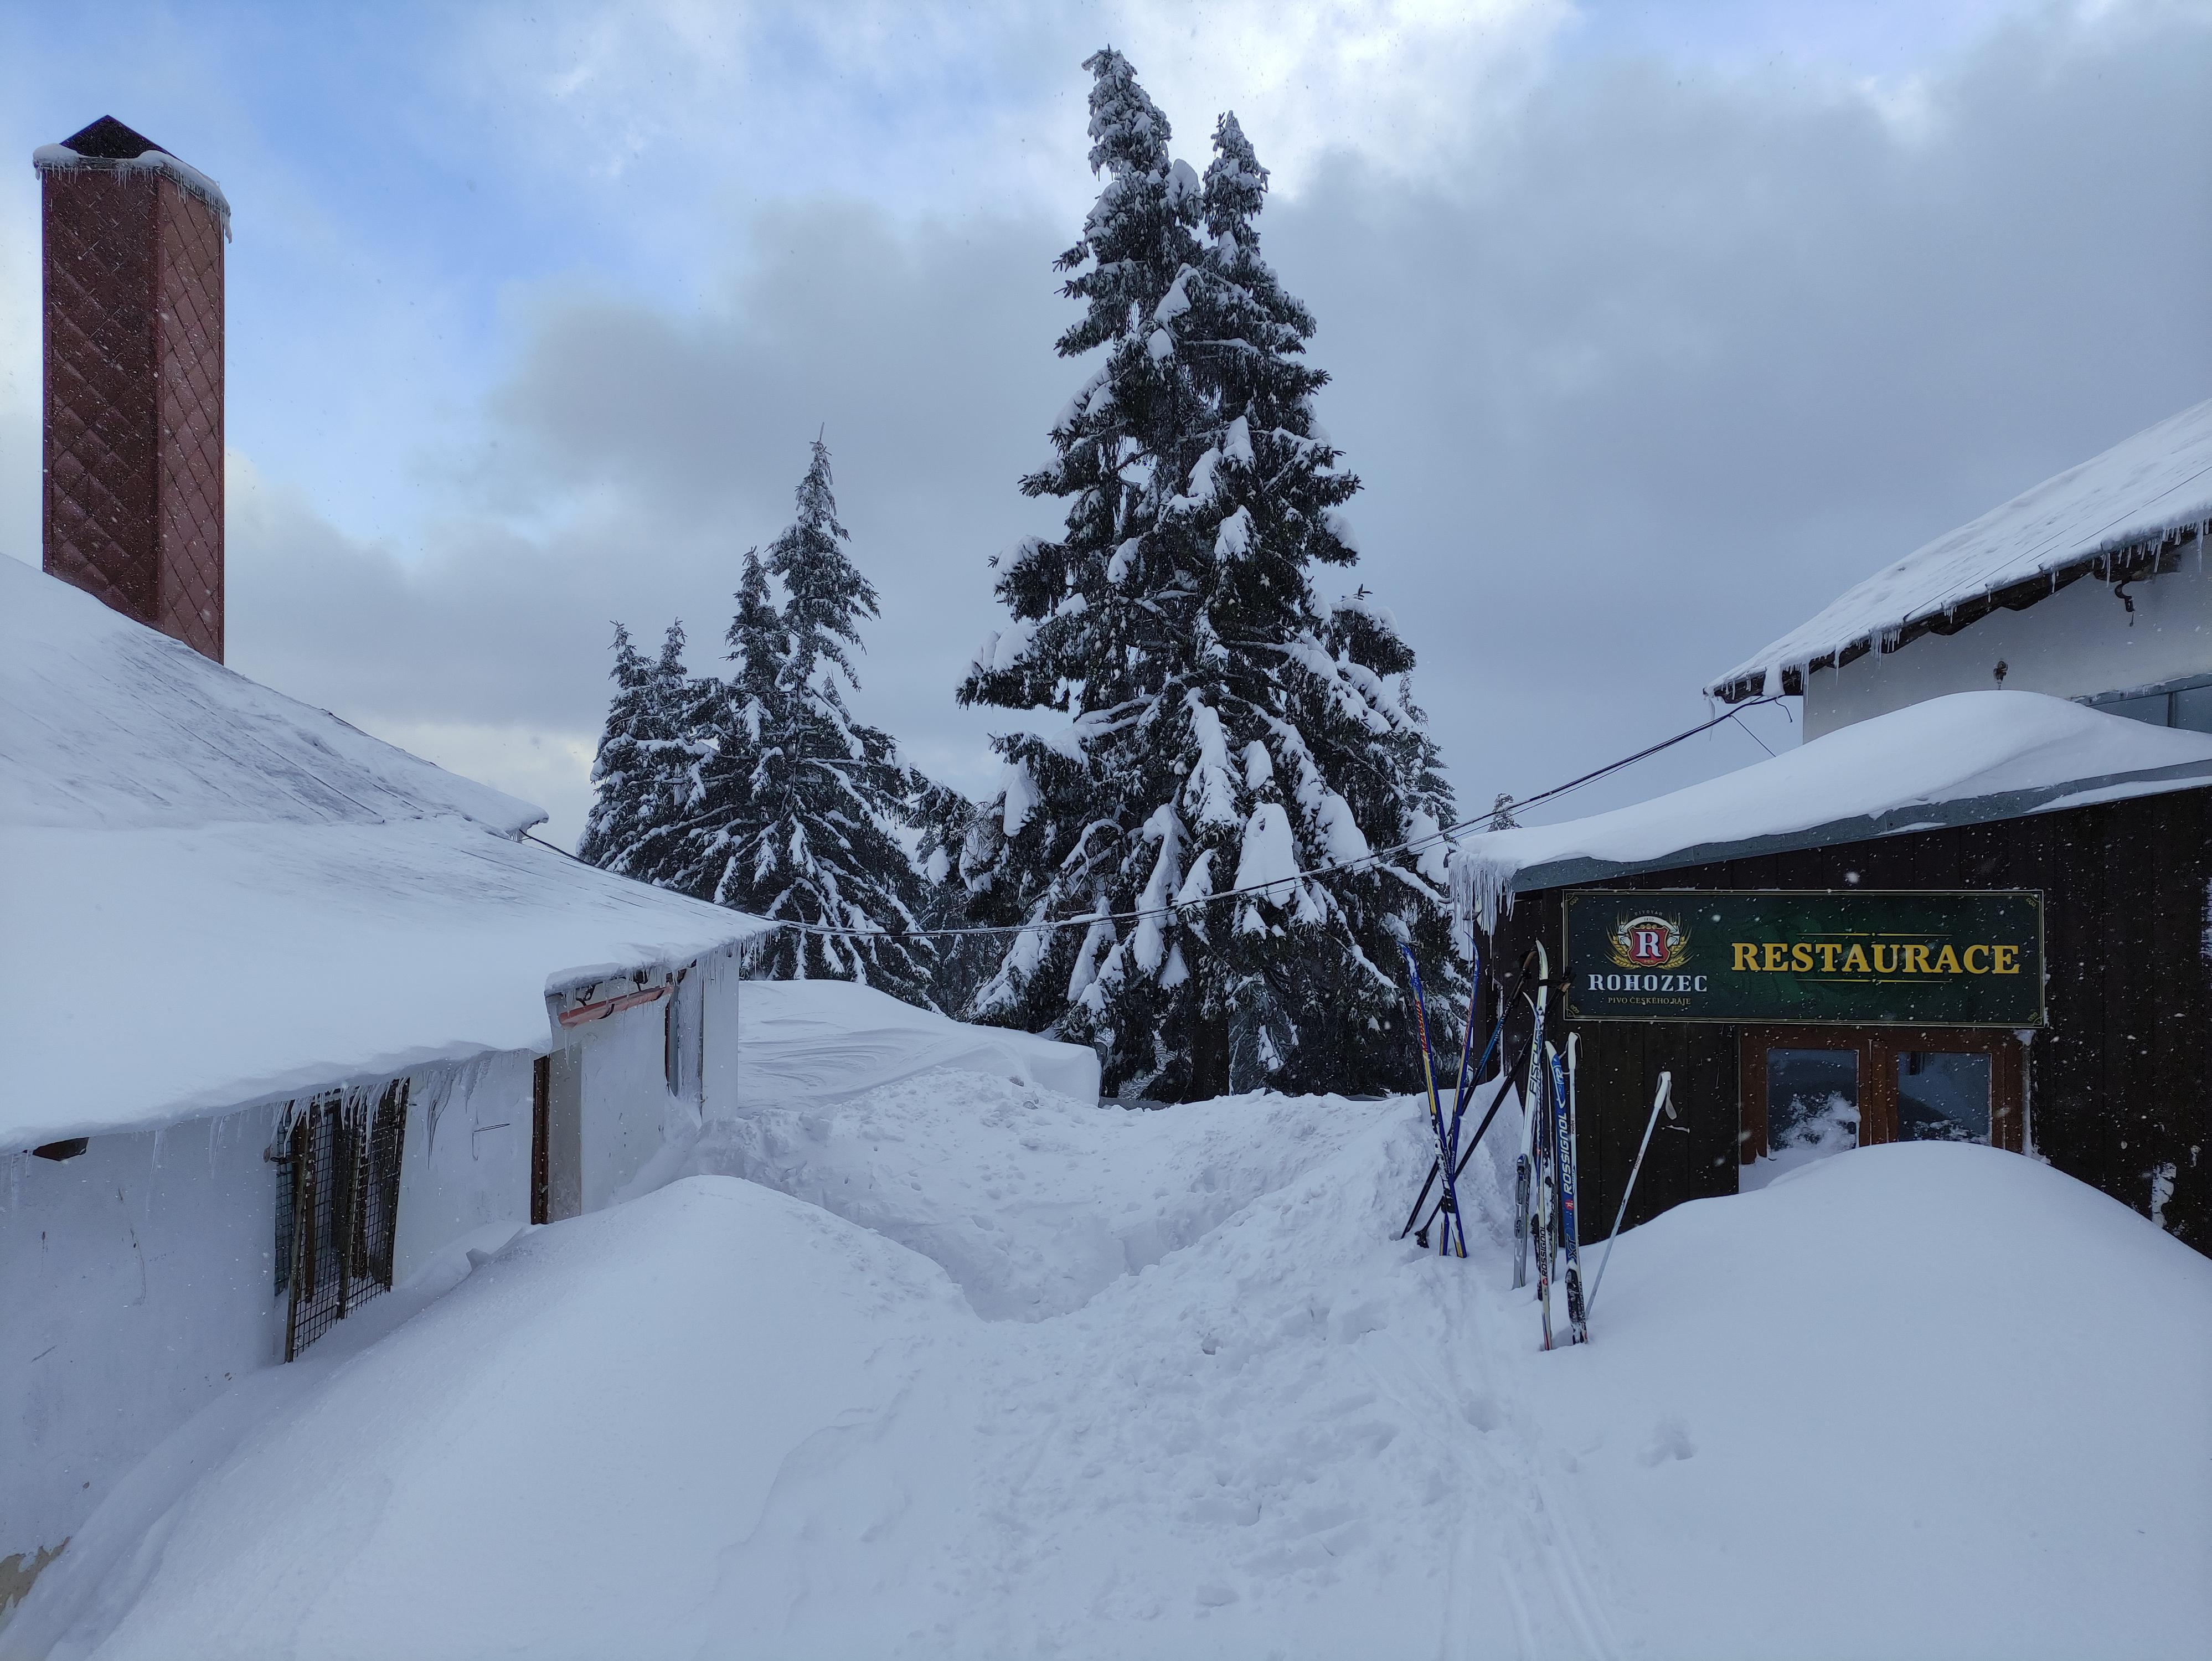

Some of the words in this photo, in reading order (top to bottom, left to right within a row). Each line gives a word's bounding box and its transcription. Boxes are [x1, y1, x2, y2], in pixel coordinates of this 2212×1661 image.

[1636, 931, 1662, 957] R
[1731, 942, 2020, 974] RESTAURACE
[1587, 973, 1708, 992] ROHOZEC
[1558, 1112, 1573, 1195] ROSSIGNOL
[1565, 1232, 1577, 1262] XT
